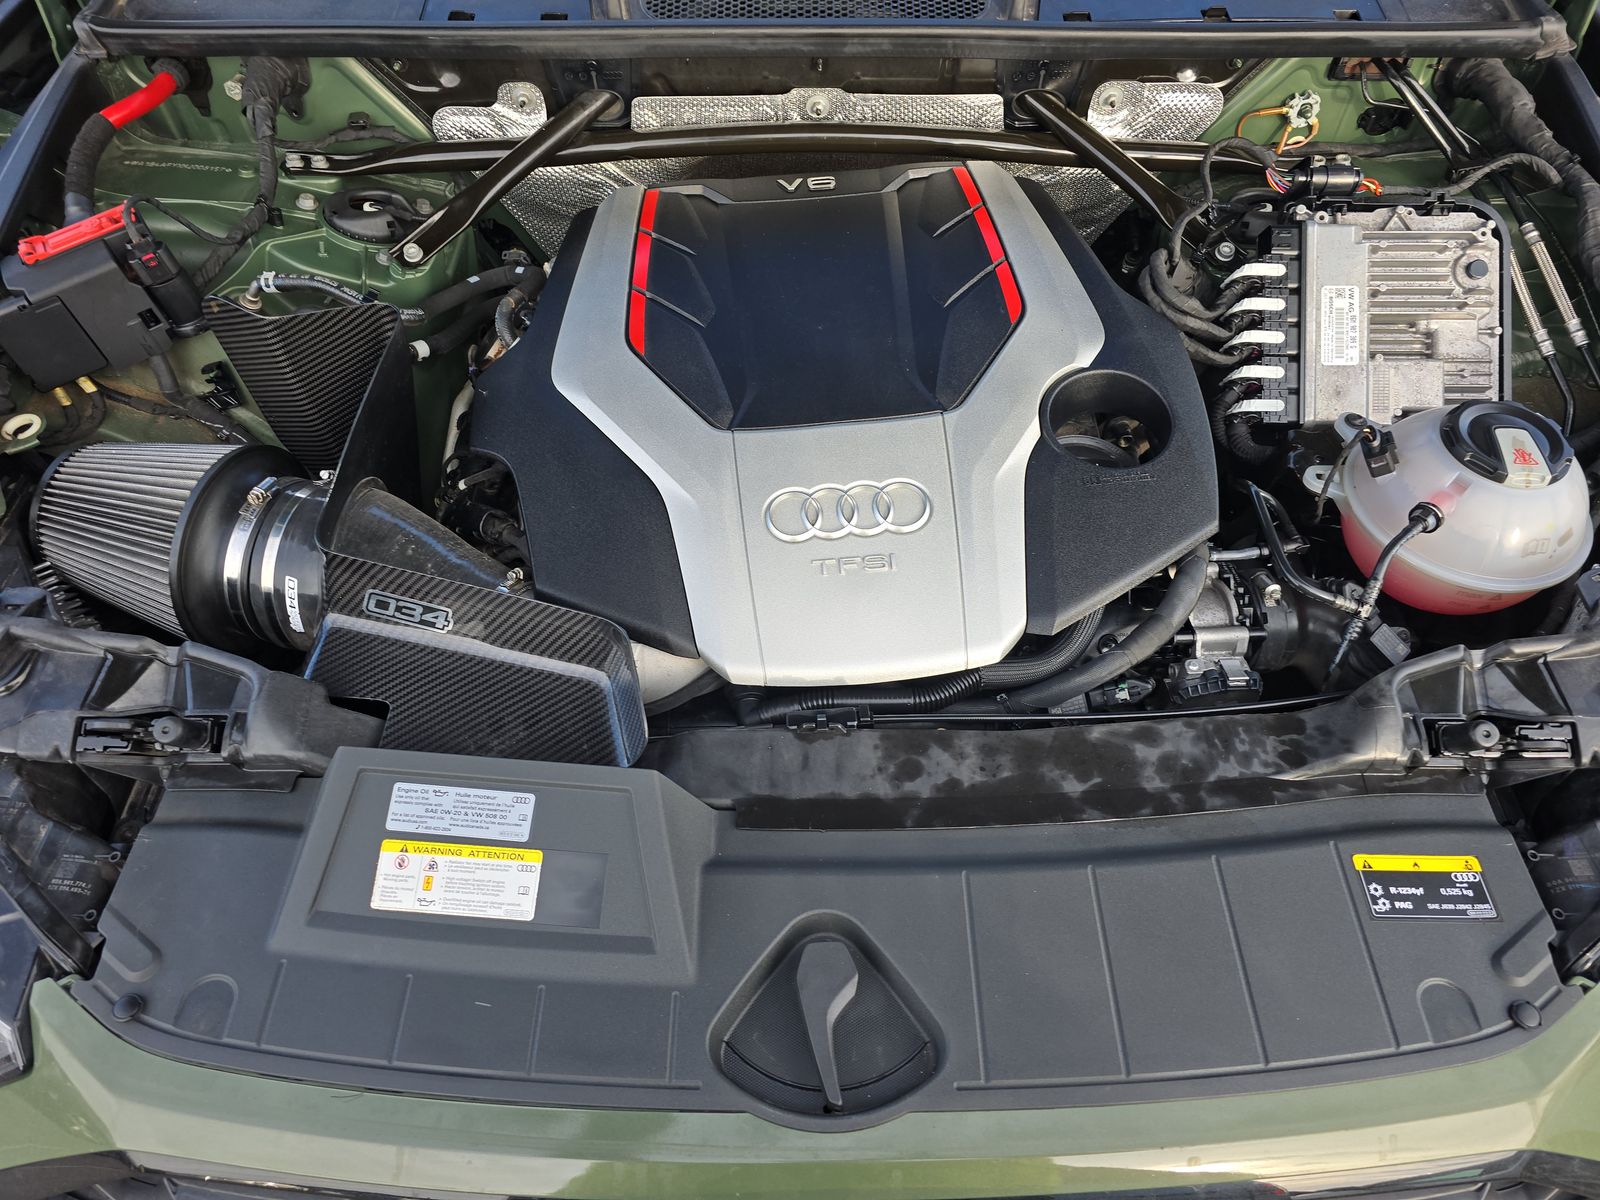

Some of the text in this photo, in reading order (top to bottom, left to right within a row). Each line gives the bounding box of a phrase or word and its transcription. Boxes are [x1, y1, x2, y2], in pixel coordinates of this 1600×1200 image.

[776, 176, 836, 192] V6
[1348, 287, 1355, 300] VW
[1348, 301, 1355, 313] AG
[810, 553, 897, 576] TFSI
[367, 593, 449, 629] 034
[413, 845, 525, 861] WARNING ATTENTION
[1388, 886, 1474, 897] R-1234yf 0,525 kg
[1394, 901, 1413, 909] PAG
